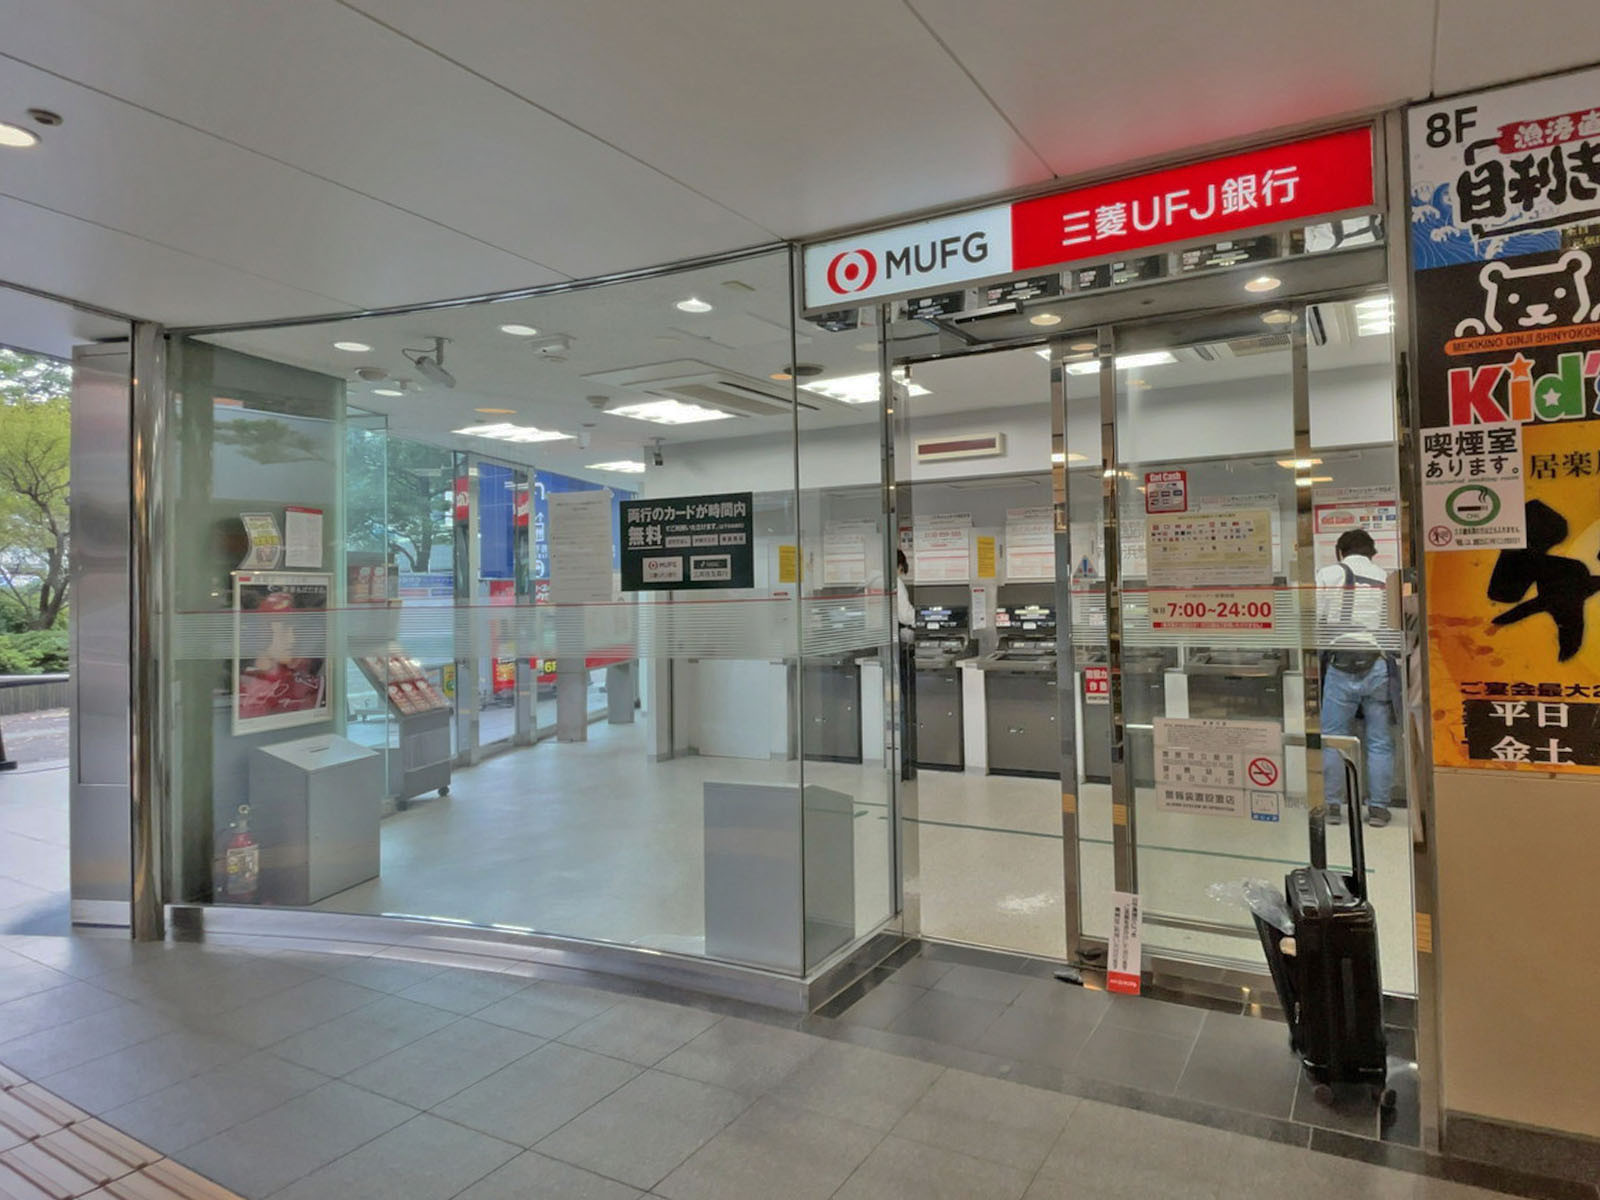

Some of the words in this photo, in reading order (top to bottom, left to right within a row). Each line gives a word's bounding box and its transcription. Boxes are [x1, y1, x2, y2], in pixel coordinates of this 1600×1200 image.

[1426, 105, 1477, 148] 8F
[1061, 165, 1299, 247] 三菱UFJ銀行
[885, 231, 989, 280] MUFG
[1506, 335, 1533, 346] GINJI
[1424, 427, 1518, 458] 喫煙室
[1425, 455, 1520, 478] あります。
[1530, 450, 1600, 480] 居楽
[627, 501, 746, 523] 両行のカードが時間内
[628, 525, 662, 546] 無料
[1488, 700, 1569, 728] 平日
[1490, 735, 1575, 765] 金土
